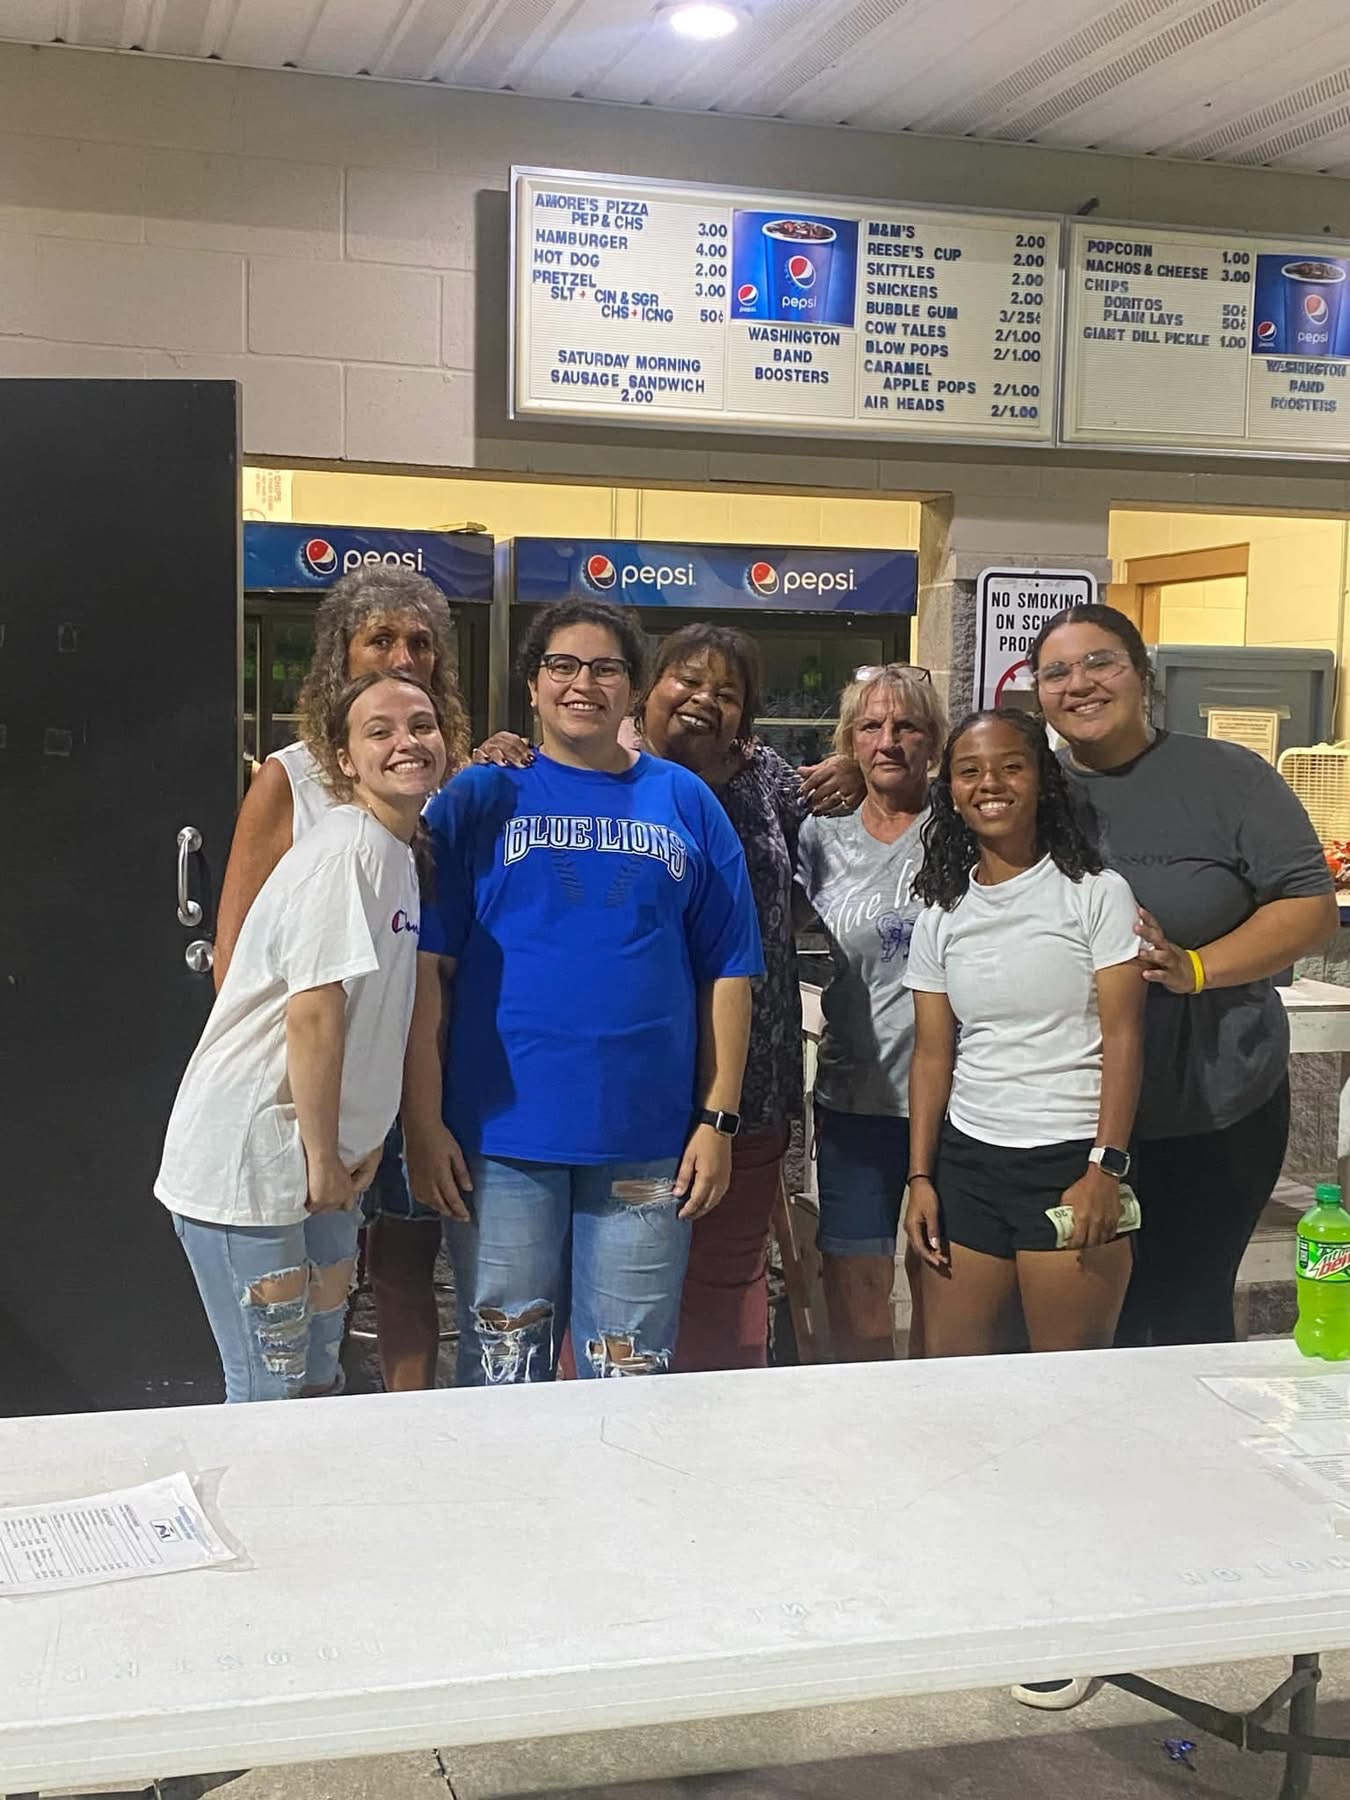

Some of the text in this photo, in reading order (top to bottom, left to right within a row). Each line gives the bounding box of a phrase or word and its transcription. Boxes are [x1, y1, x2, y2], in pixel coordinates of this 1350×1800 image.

[536, 193, 649, 216] AMORE'S PIZZA
[572, 212, 599, 227] PEP
[614, 216, 644, 231] CHS
[698, 223, 727, 238] 3.00
[868, 222, 1046, 249] M&M'S 2.00
[535, 229, 727, 258] HAMBURGER 4.00
[867, 242, 1044, 268] REESE'S CUP 2.00
[1087, 239, 1250, 265] POPCORN 1.00
[534, 248, 727, 277] HOT DOG 2.00
[1086, 259, 1250, 284] NACHOS & CHEESE 3.00
[532, 270, 726, 298] PRETZEL 3.00
[867, 262, 1043, 287] SKITTLES 2.00
[1084, 278, 1129, 293] CHIPS
[551, 286, 576, 301] SLT
[594, 289, 616, 305] CIN
[631, 293, 660, 308] SGR
[782, 295, 817, 311] pepsi
[866, 282, 1043, 306] SNICKERS 2.00
[1104, 295, 1163, 312] DORITOS
[601, 304, 629, 320] CHS
[641, 307, 674, 322] ICNG
[866, 301, 921, 318] BUBBLE
[927, 305, 958, 321] GUM
[1104, 309, 1146, 324] PLAIN
[1150, 311, 1184, 327] LAYS
[748, 327, 841, 346] WASHINGTON
[865, 320, 1041, 344] COW TALES 2/1.00
[1083, 326, 1247, 349] GIANT DILL PICKLE 1.00
[558, 350, 701, 373] SATURDAY MORNING
[773, 348, 813, 364] BAND
[865, 340, 1041, 363] BLOW POPS 2/1.00
[755, 366, 830, 384] BOOSTERS
[864, 359, 932, 377] CARAMEL
[550, 369, 705, 393] SAUSAGE SANDWICH
[883, 376, 1040, 398] APPLE POPS 2/1.00
[621, 388, 653, 403] 2.00
[864, 395, 1038, 419] AIR HEADS 2/1.00
[621, 563, 695, 590] pepsi
[784, 568, 856, 595] pepsi
[991, 591, 1010, 608] NO
[996, 613, 1015, 630] ON
[503, 815, 689, 882] BLUE LIONS
